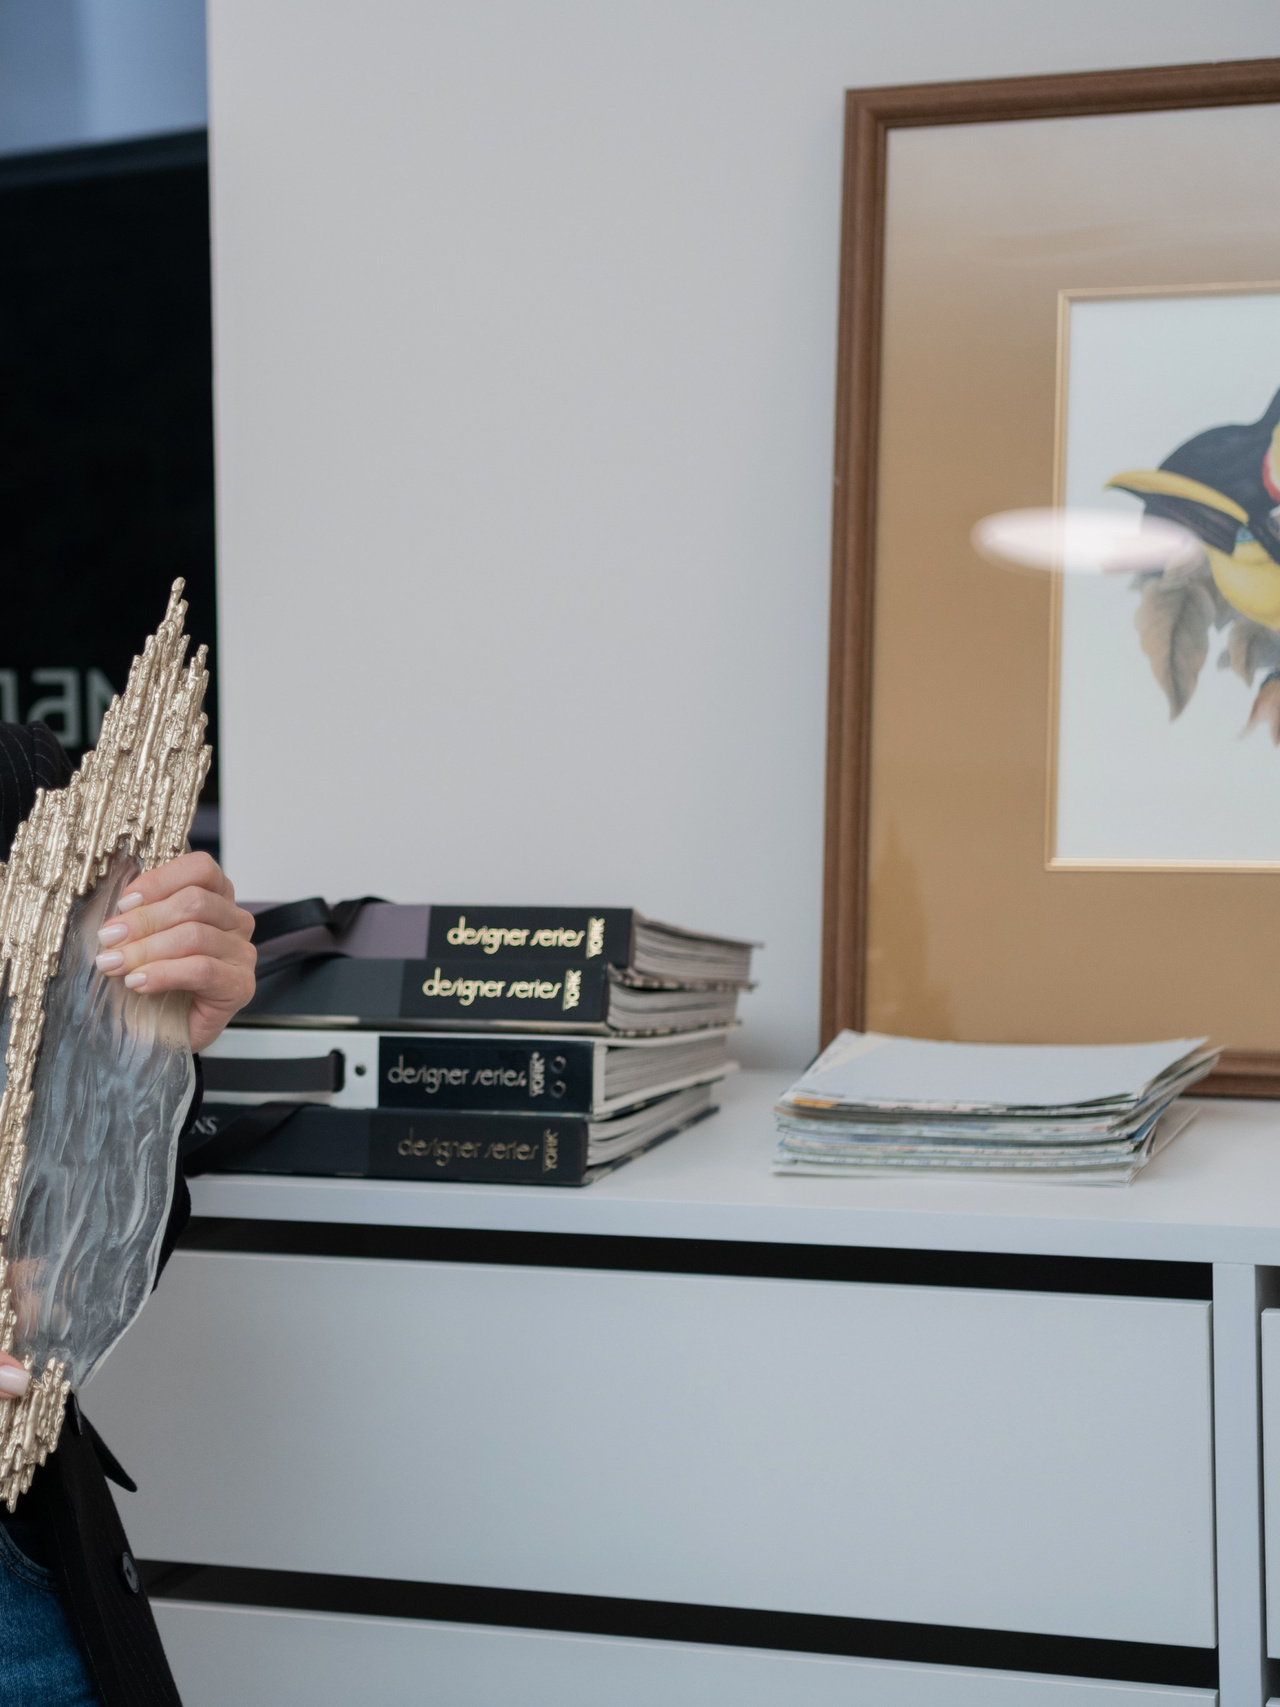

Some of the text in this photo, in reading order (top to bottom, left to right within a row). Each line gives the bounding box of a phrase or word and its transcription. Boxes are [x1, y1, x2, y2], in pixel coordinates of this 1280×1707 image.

[447, 915, 585, 955] designer series
[586, 916, 605, 960] YORK
[422, 967, 562, 1006] designer series
[562, 969, 582, 1011] YORK
[387, 1054, 470, 1094] designer
[529, 1055, 545, 1097] YORK
[398, 1127, 540, 1167] designer series
[543, 1129, 559, 1173] YORK
